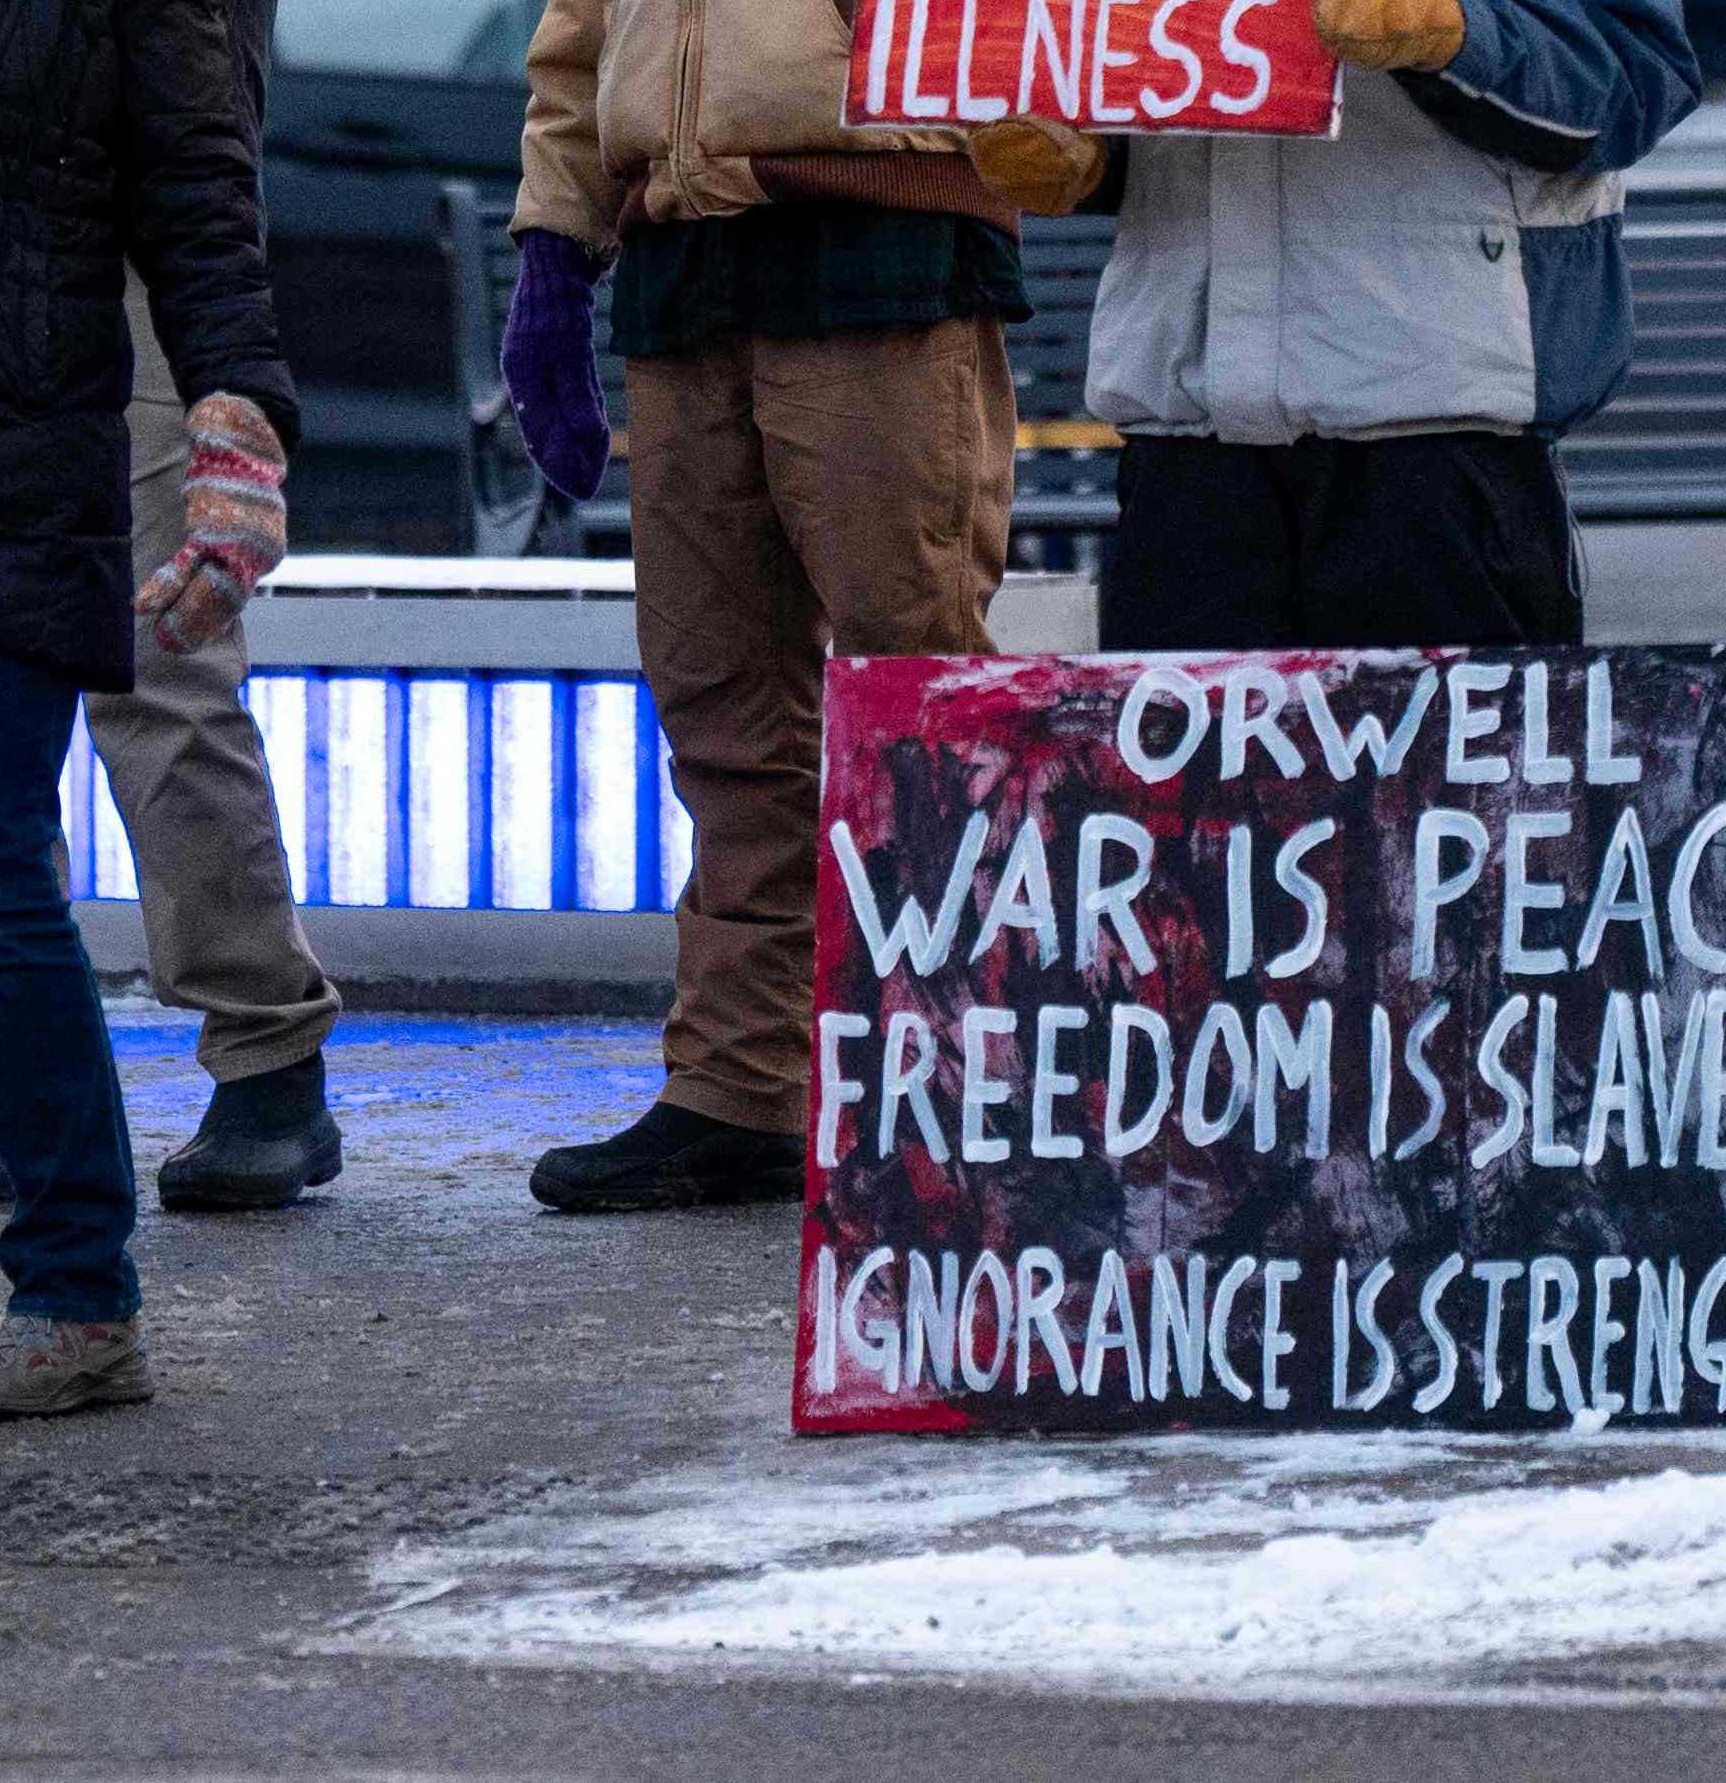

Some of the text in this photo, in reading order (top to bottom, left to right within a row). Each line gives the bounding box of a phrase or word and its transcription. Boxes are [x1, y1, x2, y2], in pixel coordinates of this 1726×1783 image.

[1115, 659, 1644, 787] ORWELL
[828, 808, 1160, 979] WAR
[1224, 818, 1336, 981] IS
[816, 998, 1334, 1170] FREEDOM
[1368, 998, 1452, 1163] IS
[813, 1246, 1303, 1412] IGNORANCE
[1331, 1252, 1396, 1413] IS
